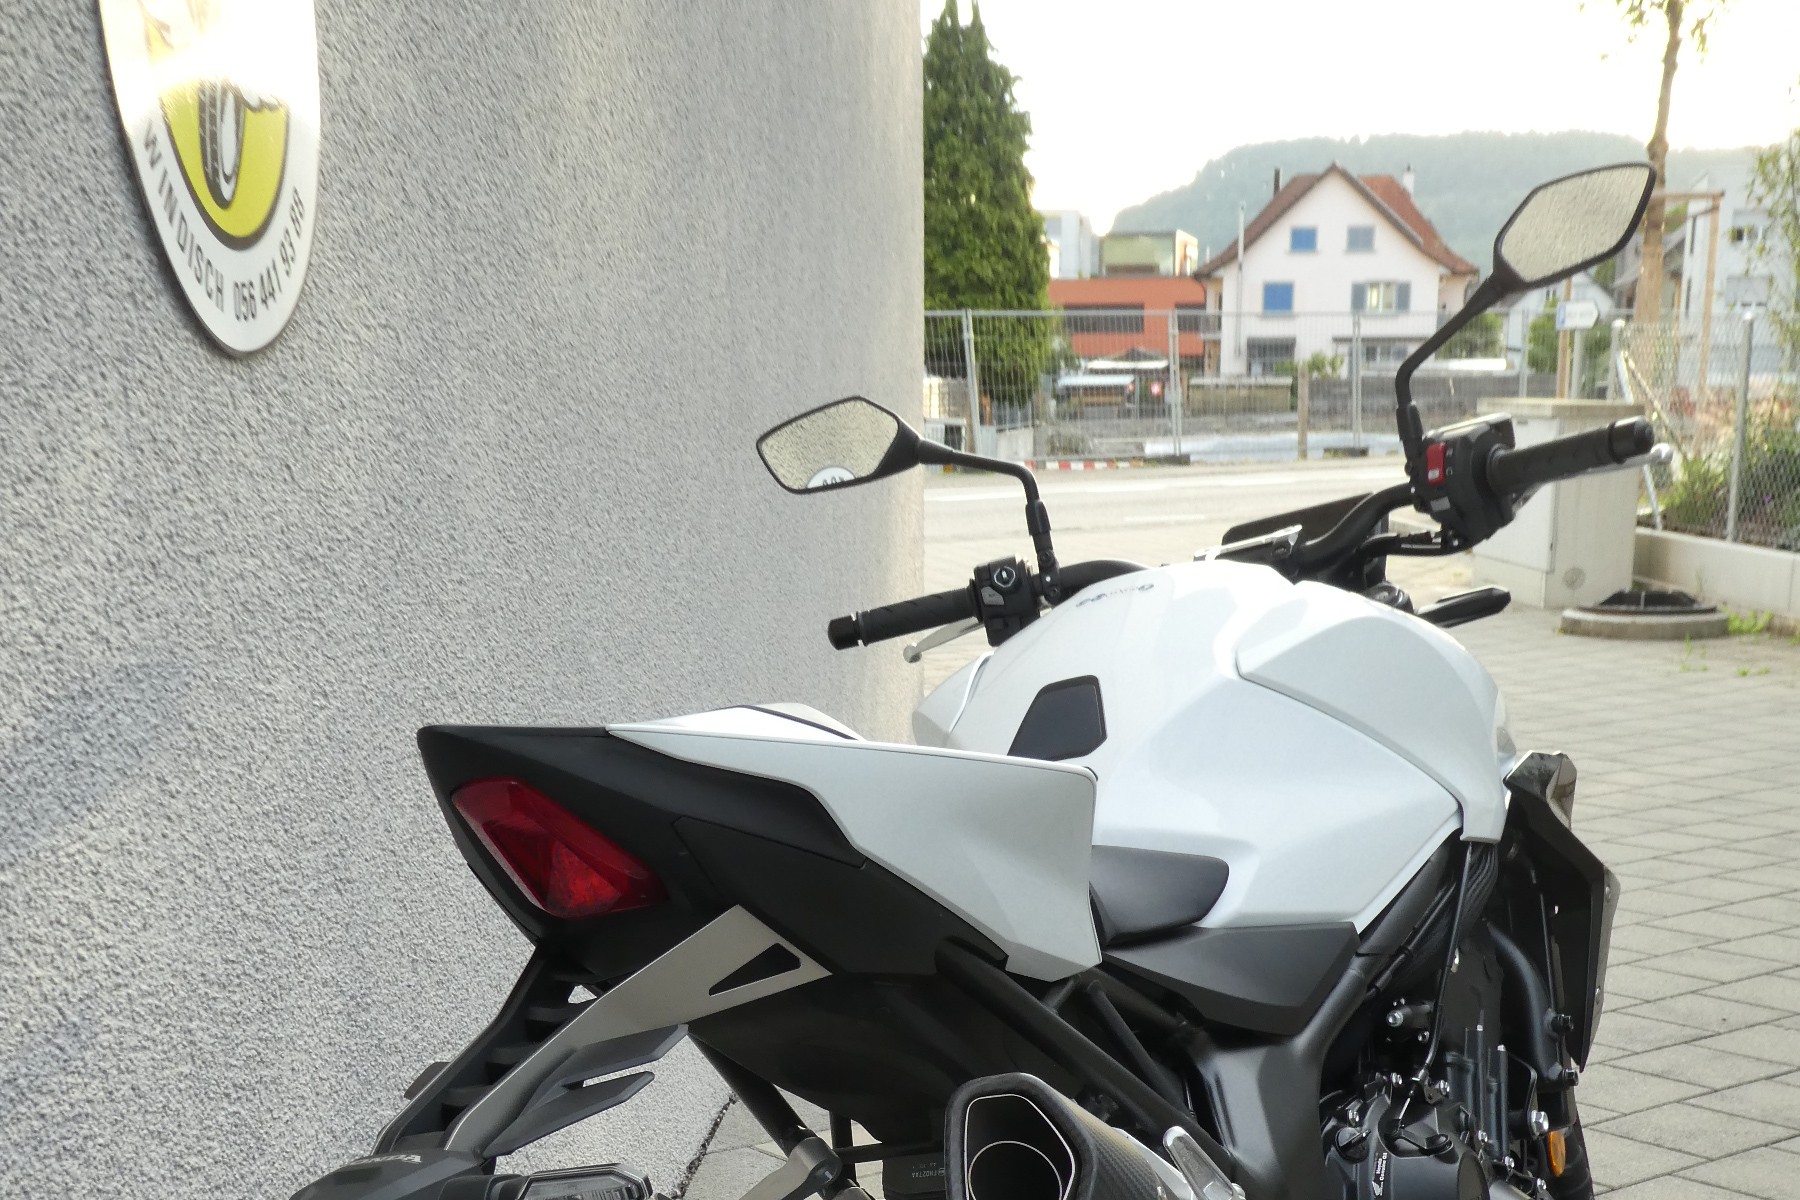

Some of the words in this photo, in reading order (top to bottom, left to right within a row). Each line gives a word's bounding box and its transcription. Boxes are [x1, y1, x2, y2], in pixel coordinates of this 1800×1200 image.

[143, 120, 226, 314] WINDISCH
[232, 279, 259, 323] 056
[258, 257, 283, 311] 441
[278, 225, 297, 279] 93
